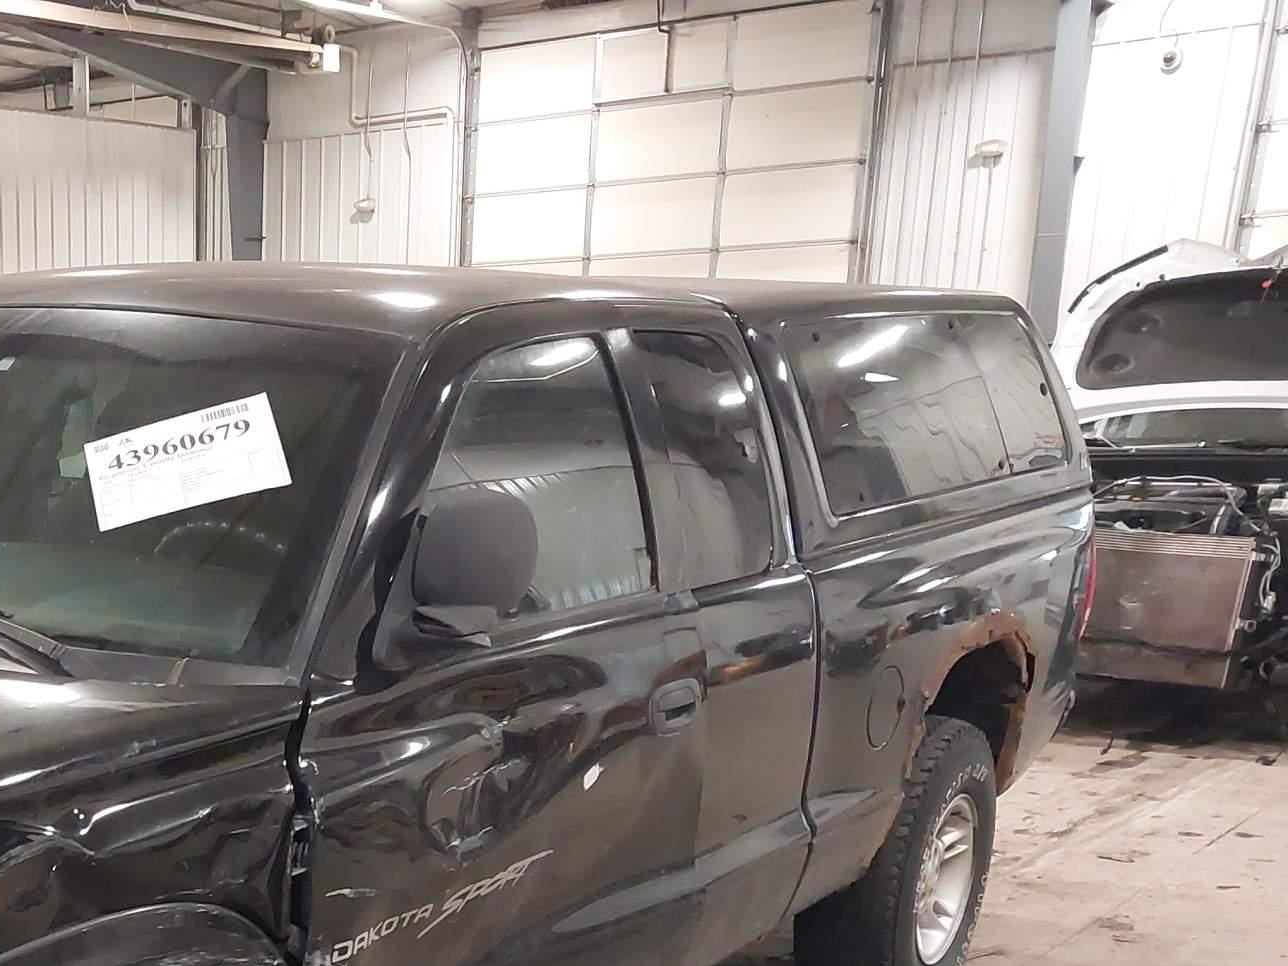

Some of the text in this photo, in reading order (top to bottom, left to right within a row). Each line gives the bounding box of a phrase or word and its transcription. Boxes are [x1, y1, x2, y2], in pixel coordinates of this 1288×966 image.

[107, 418, 251, 471] 43960679
[330, 849, 554, 963] DAKOTA SPORT
